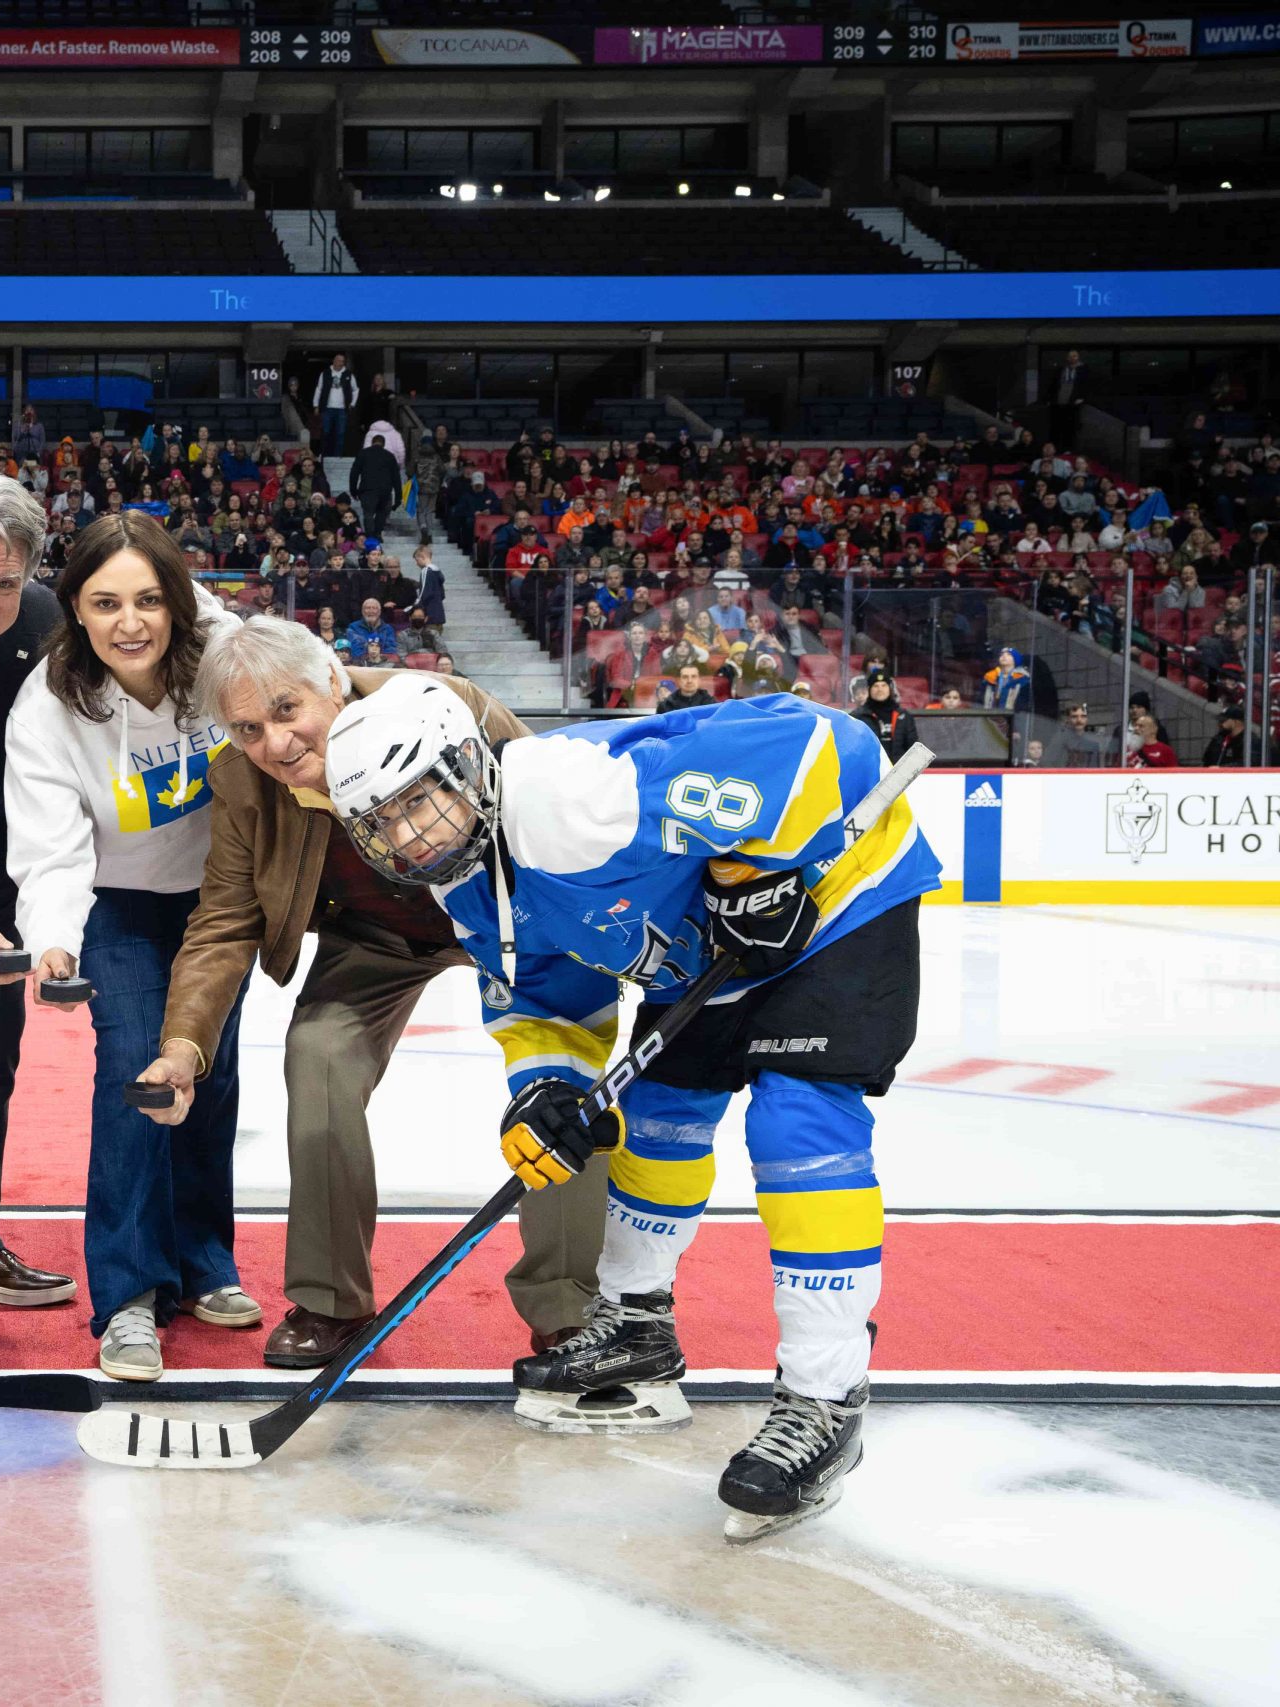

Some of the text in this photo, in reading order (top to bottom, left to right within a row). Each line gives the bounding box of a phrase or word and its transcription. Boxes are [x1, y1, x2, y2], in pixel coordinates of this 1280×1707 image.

[250, 31, 351, 44] 308 309
[662, 29, 786, 49] MAGENTA
[833, 25, 937, 40] 309 310
[32, 41, 56, 54] Act
[59, 41, 106, 54] Faster.
[109, 41, 169, 54] Remove
[170, 41, 220, 54] Waste.
[421, 38, 530, 51] TCC CANADA
[249, 50, 351, 63] 208 209
[662, 50, 787, 60] EXTERIOR SOLUTIONS
[832, 44, 937, 60] 209 210
[210, 289, 251, 310] The
[251, 368, 278, 380] 106
[894, 366, 922, 379] 107
[110, 724, 225, 774] NITED
[964, 799, 1002, 807] adidas
[703, 876, 798, 917] AUER
[788, 1274, 855, 1291] TWOL
[597, 1356, 629, 1370] BAUER
